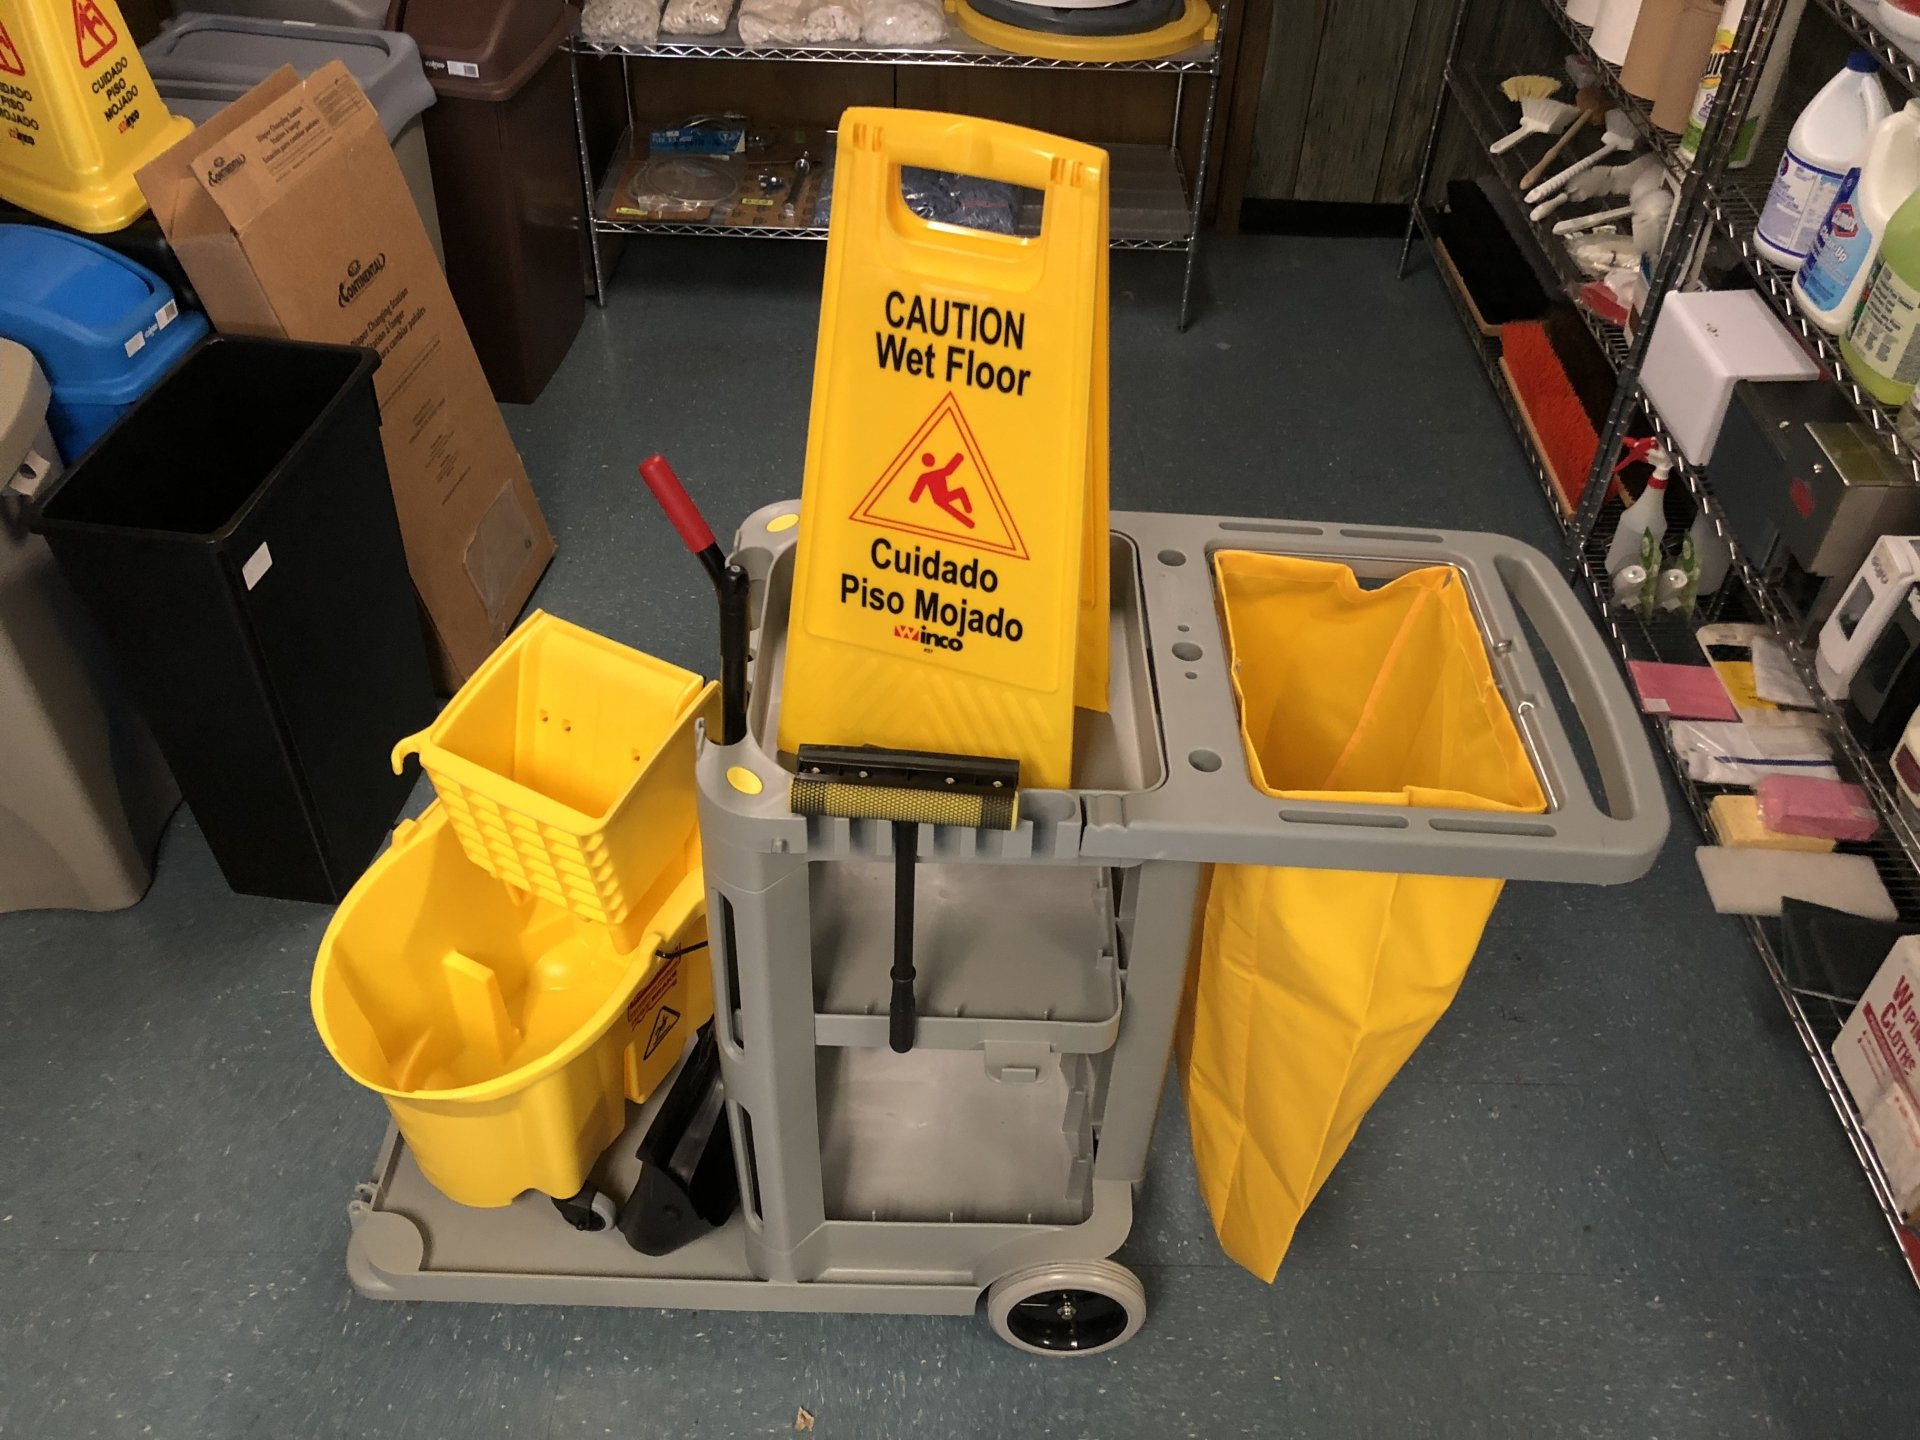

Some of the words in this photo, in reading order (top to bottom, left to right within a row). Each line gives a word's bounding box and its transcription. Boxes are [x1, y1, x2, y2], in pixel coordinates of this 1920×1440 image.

[92, 57, 128, 94] CUIDADO
[104, 85, 138, 122] MOJADO
[106, 78, 126, 101] PISO
[339, 253, 386, 307] CONTINENTAL
[885, 290, 1025, 350] CAUTION
[875, 331, 936, 379] Wet
[945, 345, 1032, 396] Floor
[870, 537, 999, 593] Cuidado
[841, 573, 904, 615] Piso
[914, 588, 1023, 642] Mojado
[1880, 1002, 1916, 1072] CLOTHS
